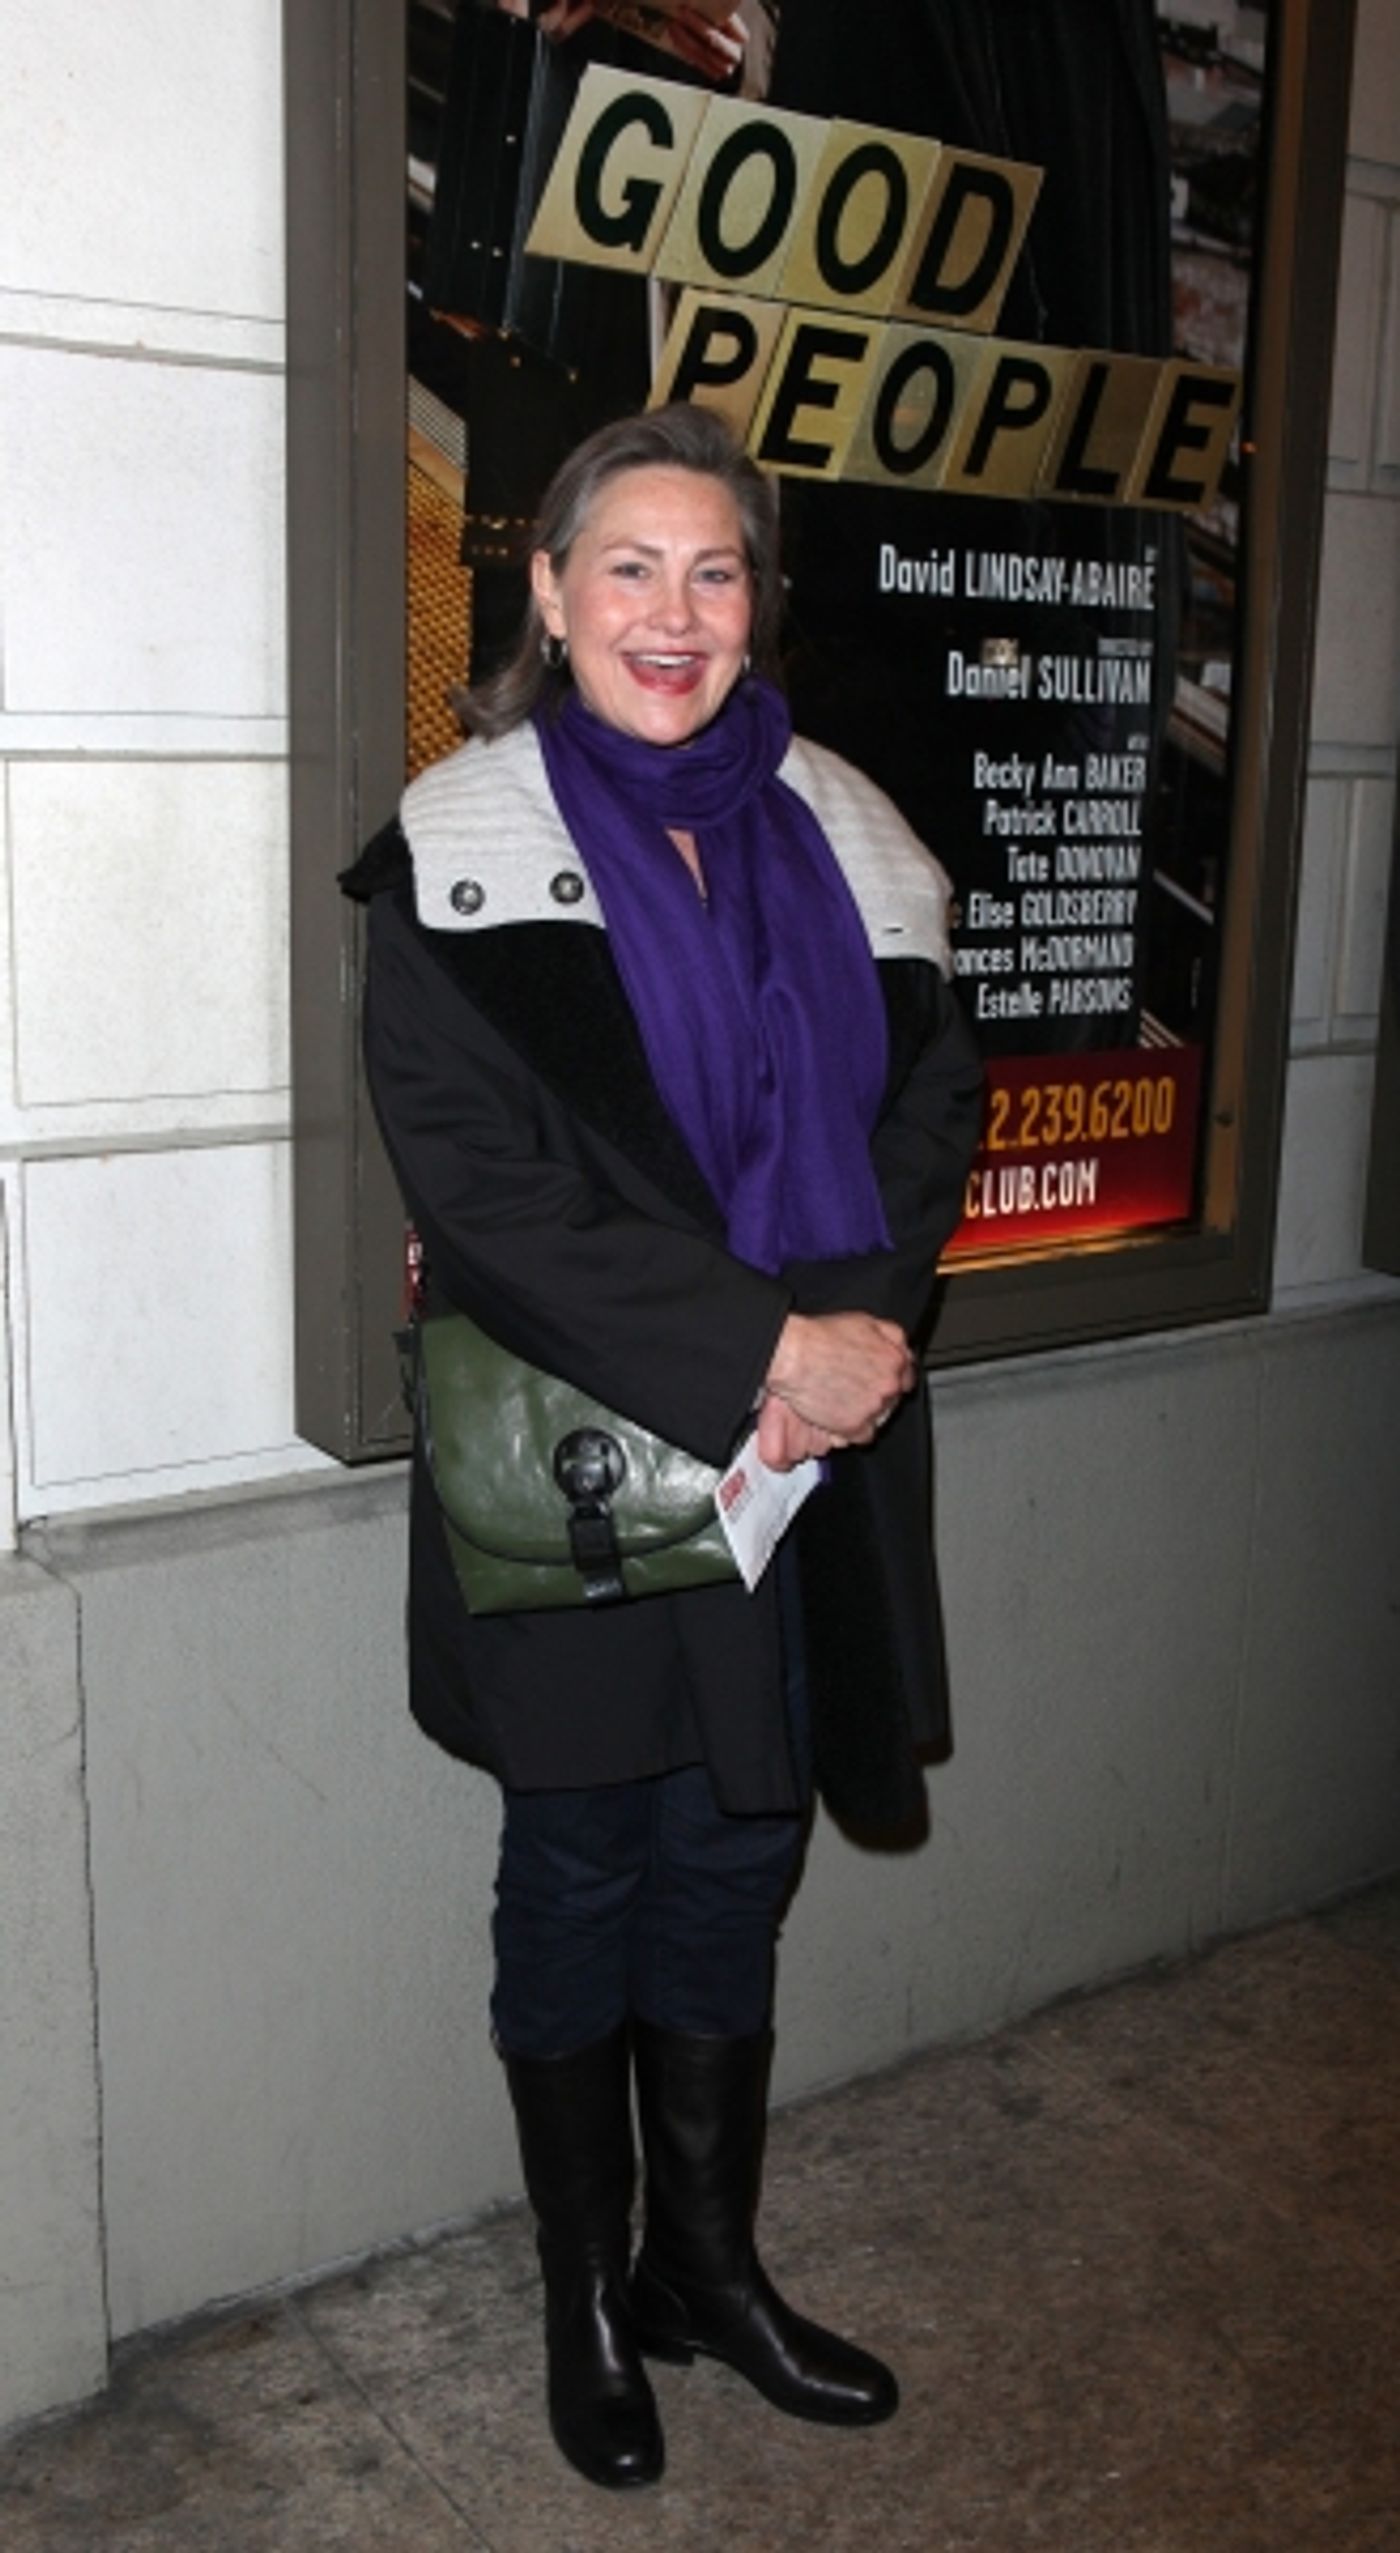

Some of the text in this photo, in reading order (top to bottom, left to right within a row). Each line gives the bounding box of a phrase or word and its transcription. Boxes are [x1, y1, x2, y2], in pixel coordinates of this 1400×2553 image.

[574, 90, 1016, 317] GOOD
[669, 307, 1236, 502] PEOPLE
[879, 543, 1155, 610] David LINDSAY-ABAIRE
[947, 650, 1151, 703] Daniel SULLIVAN
[973, 750, 1146, 798] Becky Ann BAKER
[983, 799, 1143, 836] Patrick CARROLL
[1007, 845, 1142, 883] Tate DONOVAN
[969, 891, 1015, 929] Elise
[1020, 890, 1139, 927] GOLDSBERRY
[955, 932, 1135, 976] ances McDORMAND
[976, 978, 1134, 1020] Estelle PARSONS
[987, 1076, 1175, 1151] 2.239.6200
[964, 1158, 1099, 1219] CLUB.COM
